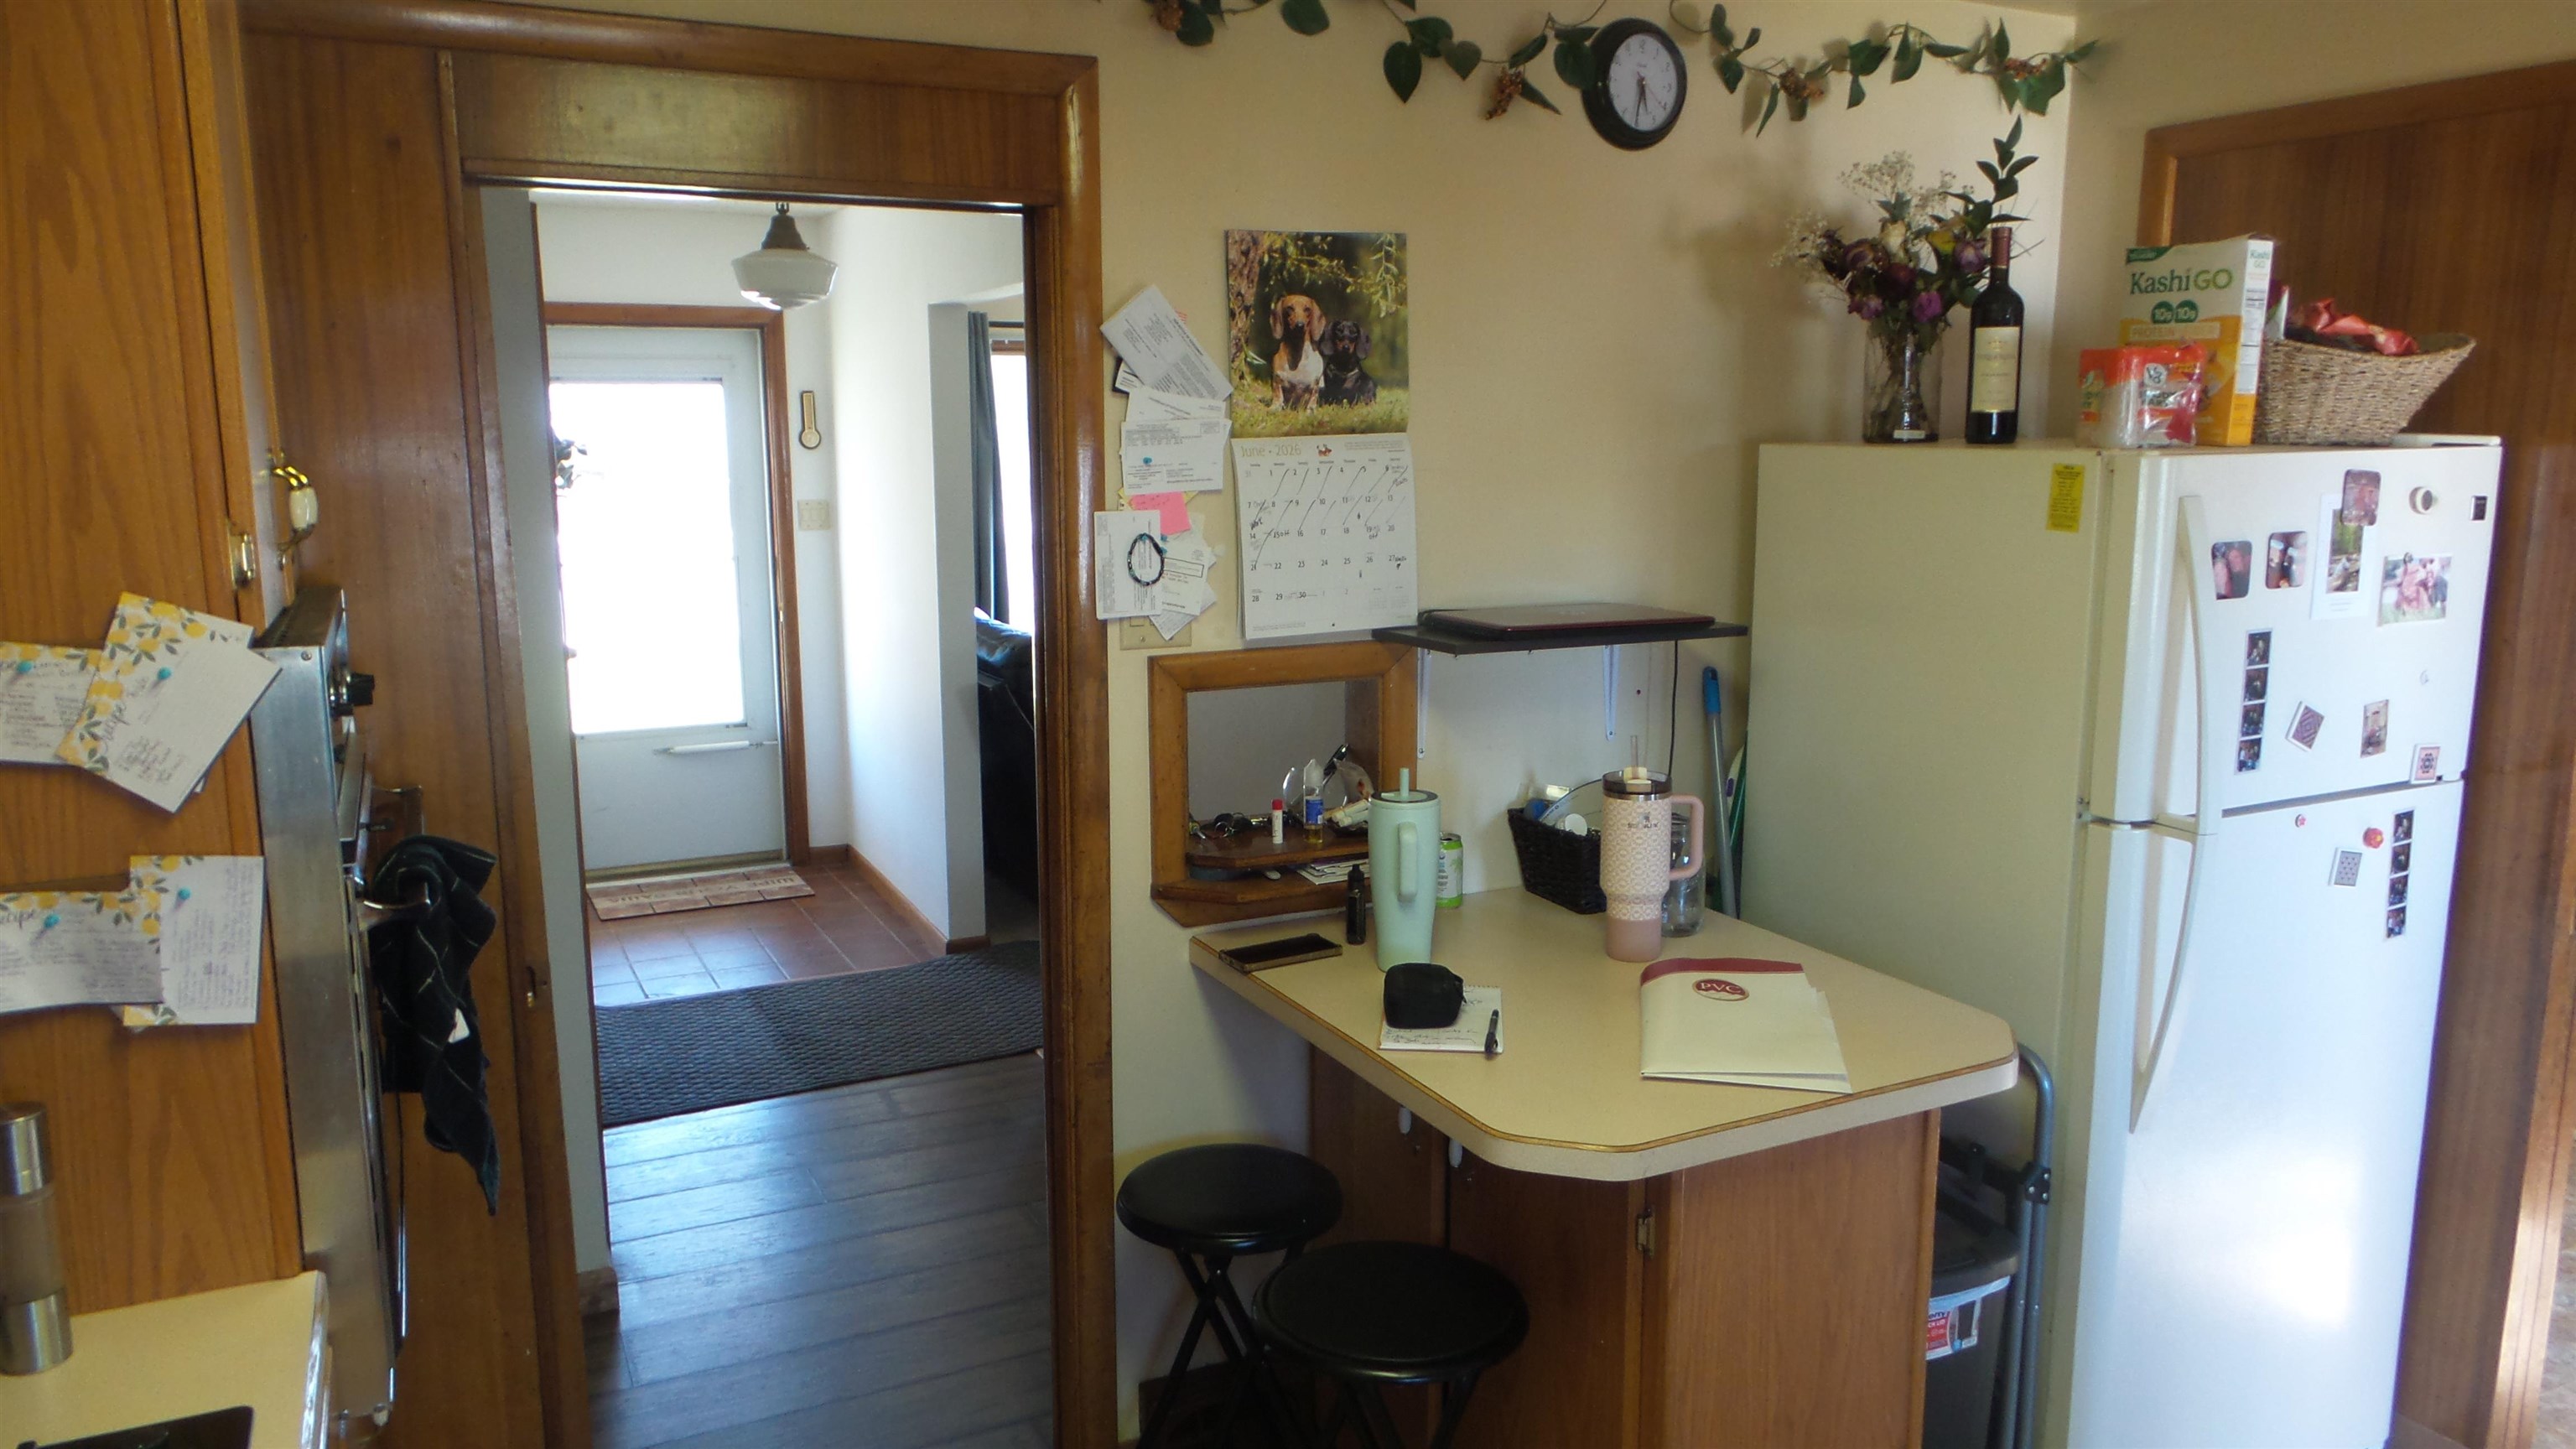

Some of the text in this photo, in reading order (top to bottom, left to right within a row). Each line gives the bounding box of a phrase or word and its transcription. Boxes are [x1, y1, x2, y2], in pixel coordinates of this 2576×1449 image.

[2130, 267, 2233, 294] Kashi GO
[2177, 306, 2196, 319] 10g
[1240, 444, 1302, 458] June 2026
[1700, 982, 1742, 994] PVC
